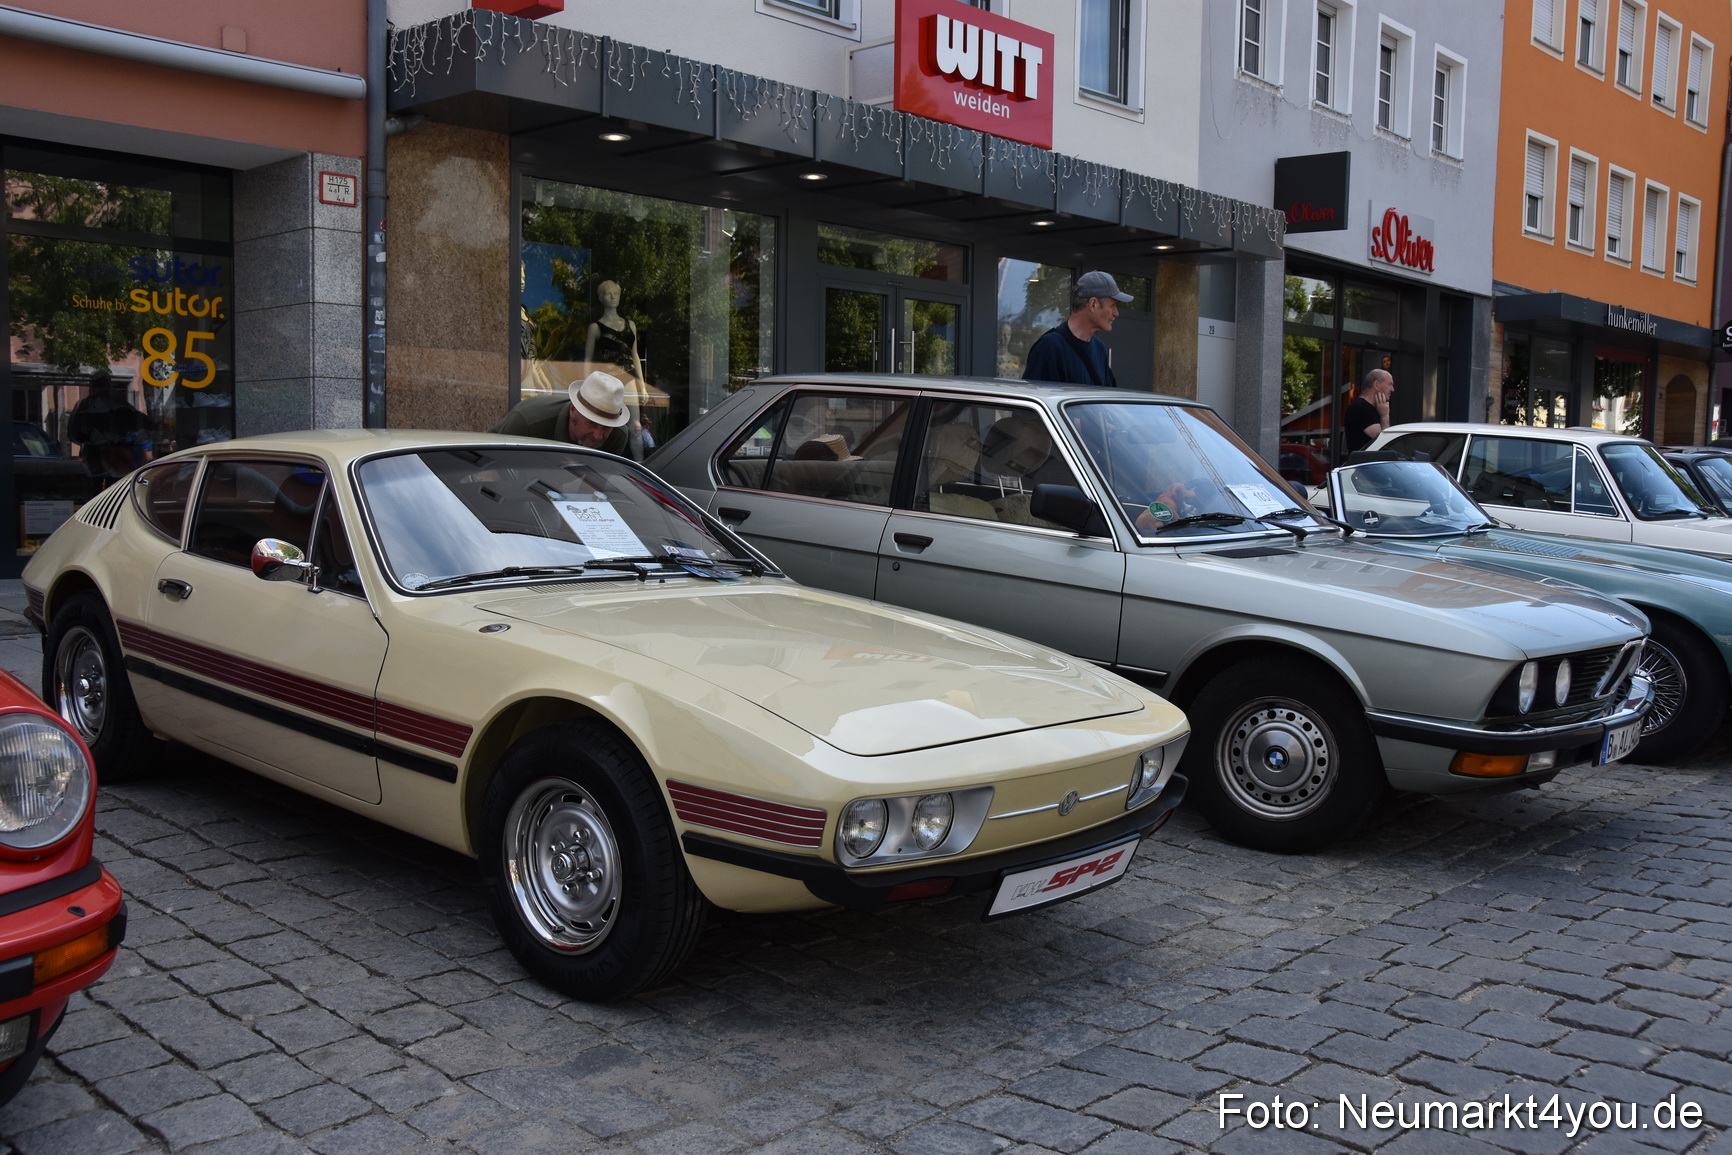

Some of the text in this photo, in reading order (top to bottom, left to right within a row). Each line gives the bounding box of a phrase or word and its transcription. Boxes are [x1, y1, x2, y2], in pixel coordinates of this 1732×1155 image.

[936, 13, 1043, 100] WITT
[953, 90, 1010, 119] weiden
[1371, 207, 1435, 272] s.Oliver
[72, 287, 225, 319] Schuhe by sutor.
[1607, 303, 1658, 336] hunkemöller
[140, 327, 217, 389] 85
[1608, 734, 1614, 759] B
